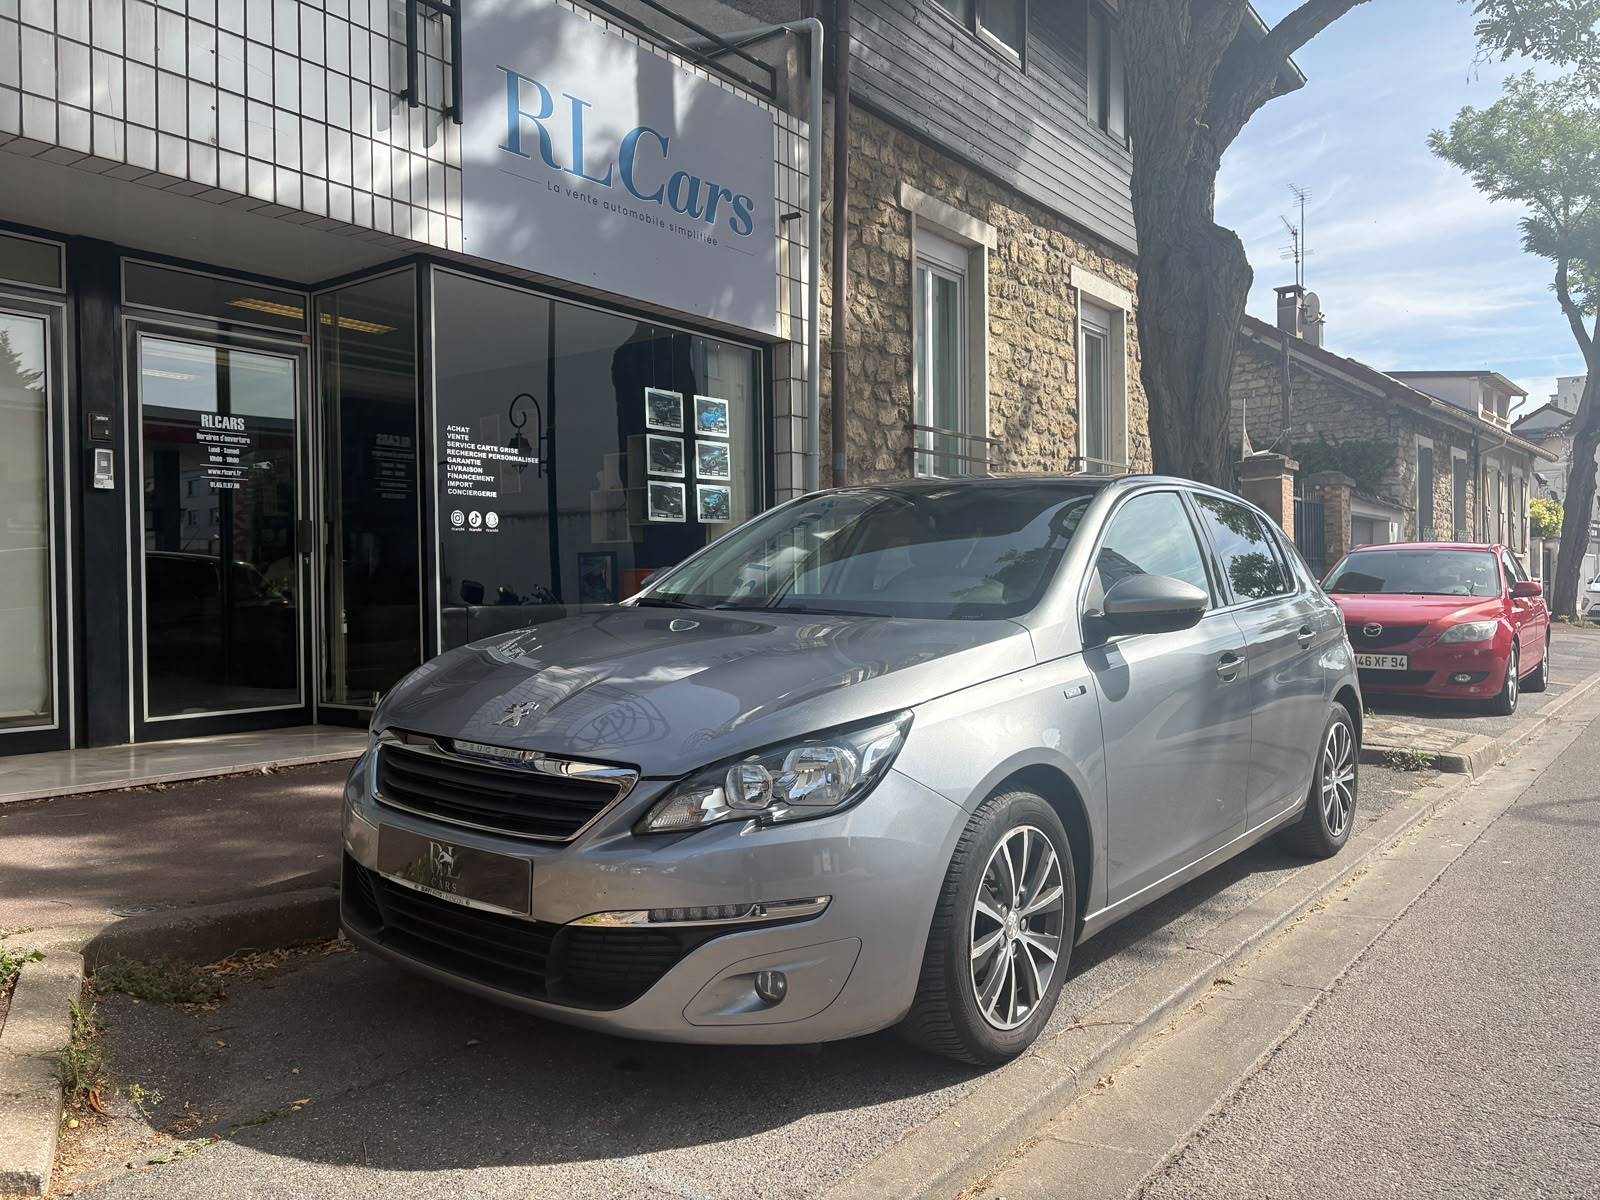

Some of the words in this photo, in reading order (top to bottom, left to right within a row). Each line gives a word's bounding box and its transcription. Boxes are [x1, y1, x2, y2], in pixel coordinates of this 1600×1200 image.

[496, 64, 754, 237] RLCars
[547, 180, 561, 193] La
[565, 187, 600, 206] vente
[602, 200, 665, 229] automobile
[668, 223, 719, 247] simplifiée
[201, 414, 245, 431] RLCARS
[447, 425, 470, 433] ACHAT
[447, 433, 469, 441] VENTE
[447, 441, 475, 450] SERVICE
[476, 444, 498, 452] CARTE
[499, 446, 519, 454] GRISE
[447, 449, 487, 459] RECHERCHE
[447, 457, 481, 466] GARANTIE
[447, 465, 483, 473] LIVRAISON
[447, 473, 495, 482] FINANCEMENT
[447, 489, 497, 498] CONCIERGERIE
[1355, 655, 1371, 667] 46
[1374, 656, 1388, 667] XF
[1391, 657, 1405, 668] 94
